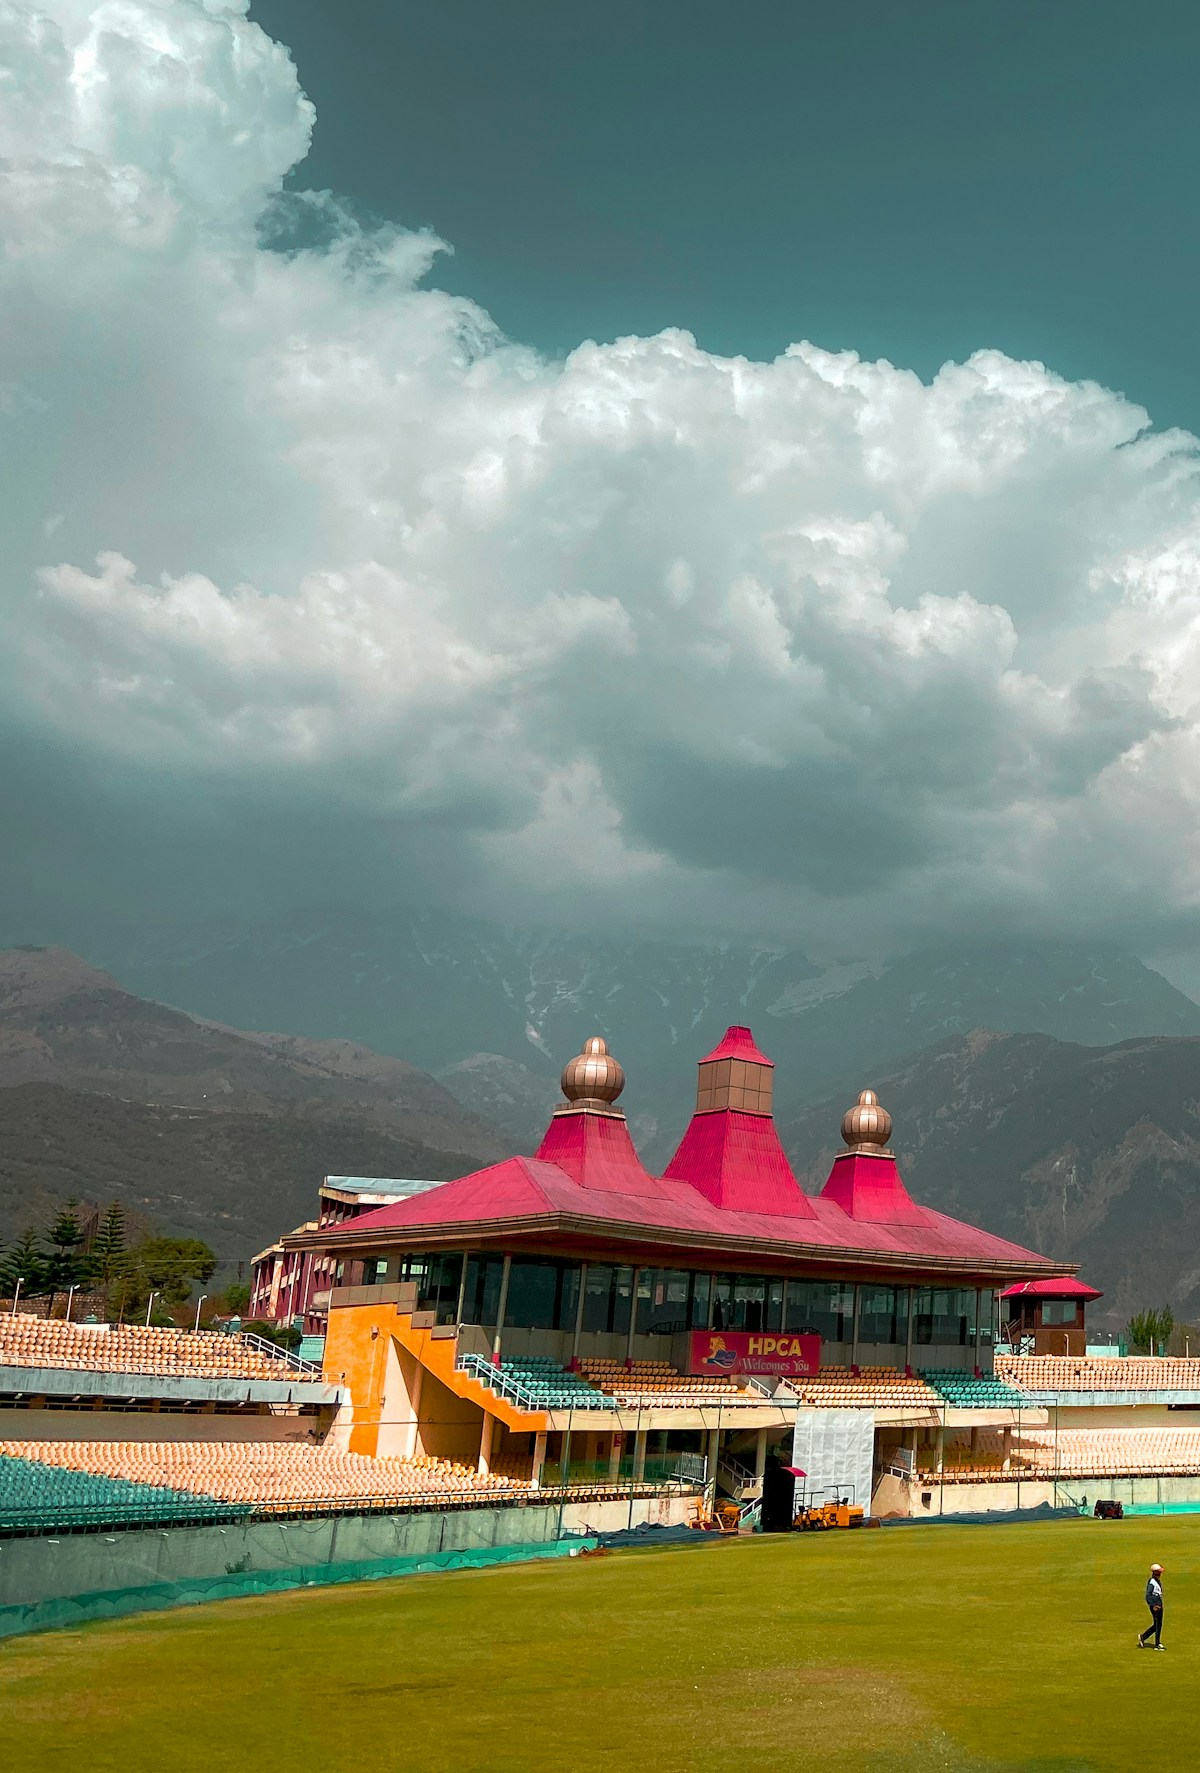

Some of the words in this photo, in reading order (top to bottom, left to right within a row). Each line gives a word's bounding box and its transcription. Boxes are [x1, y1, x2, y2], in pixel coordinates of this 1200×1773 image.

[749, 1337, 801, 1357] HPCA
[739, 1358, 790, 1371] Welcomes
[793, 1360, 809, 1371] You
